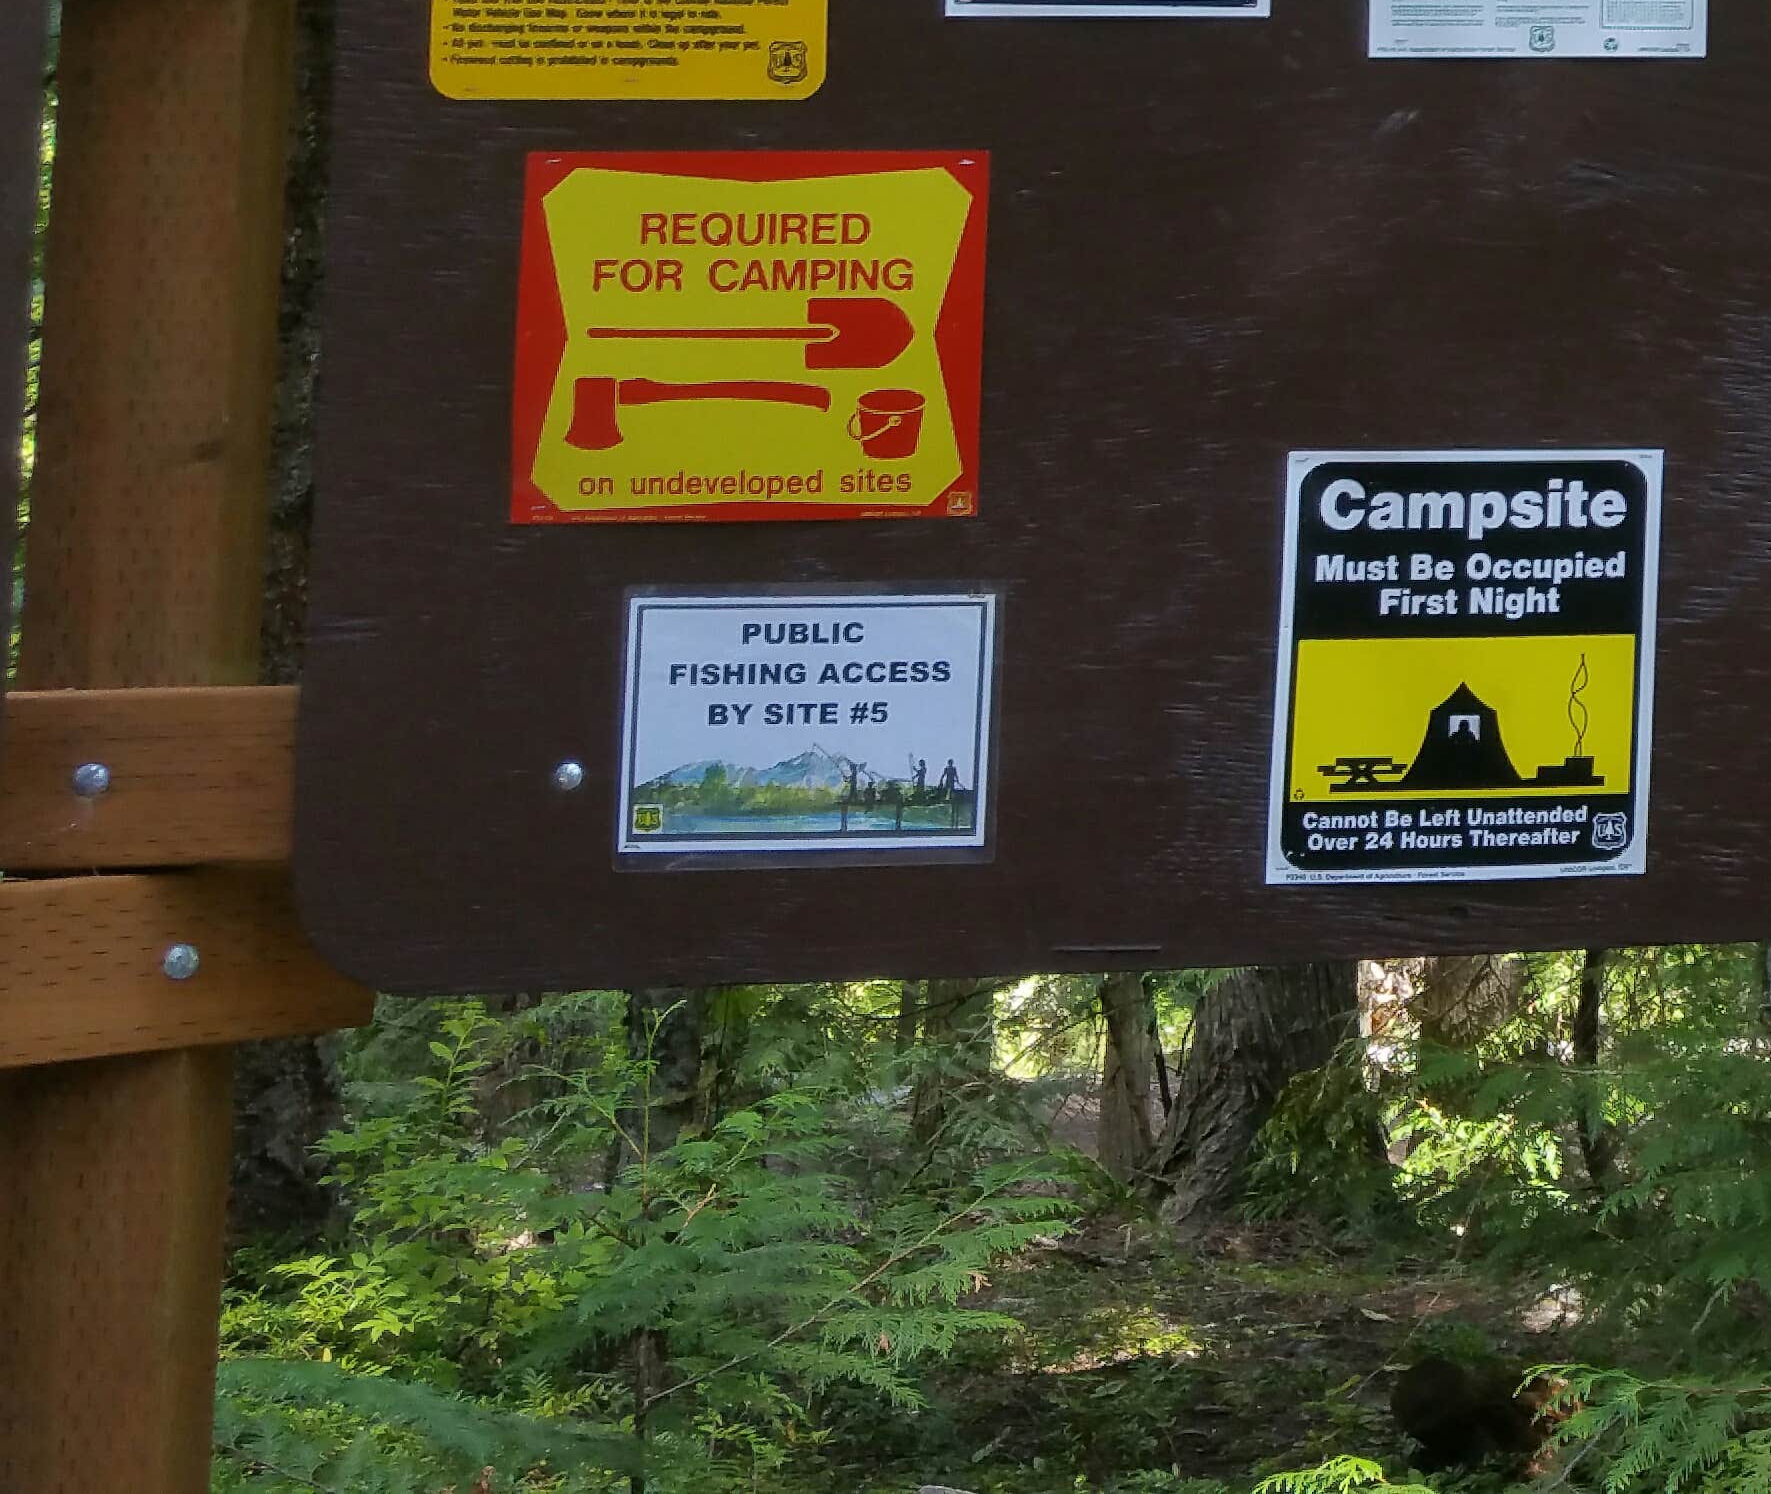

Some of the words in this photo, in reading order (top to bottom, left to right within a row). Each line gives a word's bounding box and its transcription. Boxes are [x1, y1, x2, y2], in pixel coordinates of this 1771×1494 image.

[640, 213, 871, 246] REQUIRED
[593, 259, 684, 292] FOR
[709, 258, 913, 291] CAMPING
[579, 476, 614, 496] on
[631, 471, 824, 499] undeveloped
[840, 470, 912, 494] sites
[1320, 478, 1628, 539] Campsite
[1315, 554, 1399, 582] Must
[1411, 554, 1455, 579] Be
[1466, 552, 1626, 584] Occupied
[1379, 589, 1458, 616] First
[1469, 587, 1560, 620] Night
[742, 622, 865, 644] PUBLIC
[670, 663, 807, 686] FISHING
[818, 661, 951, 684] ACCESS
[708, 704, 753, 726] BY
[763, 704, 838, 725] SITE
[850, 702, 888, 724] #5
[1303, 811, 1379, 830] Cannot
[1386, 811, 1412, 828] Be
[1419, 809, 1460, 827] Left
[1467, 806, 1588, 825] Unattended
[1308, 833, 1358, 851] Over
[1365, 833, 1393, 849] 24
[1400, 831, 1462, 849] Hours
[1471, 829, 1580, 847] Thereafter
